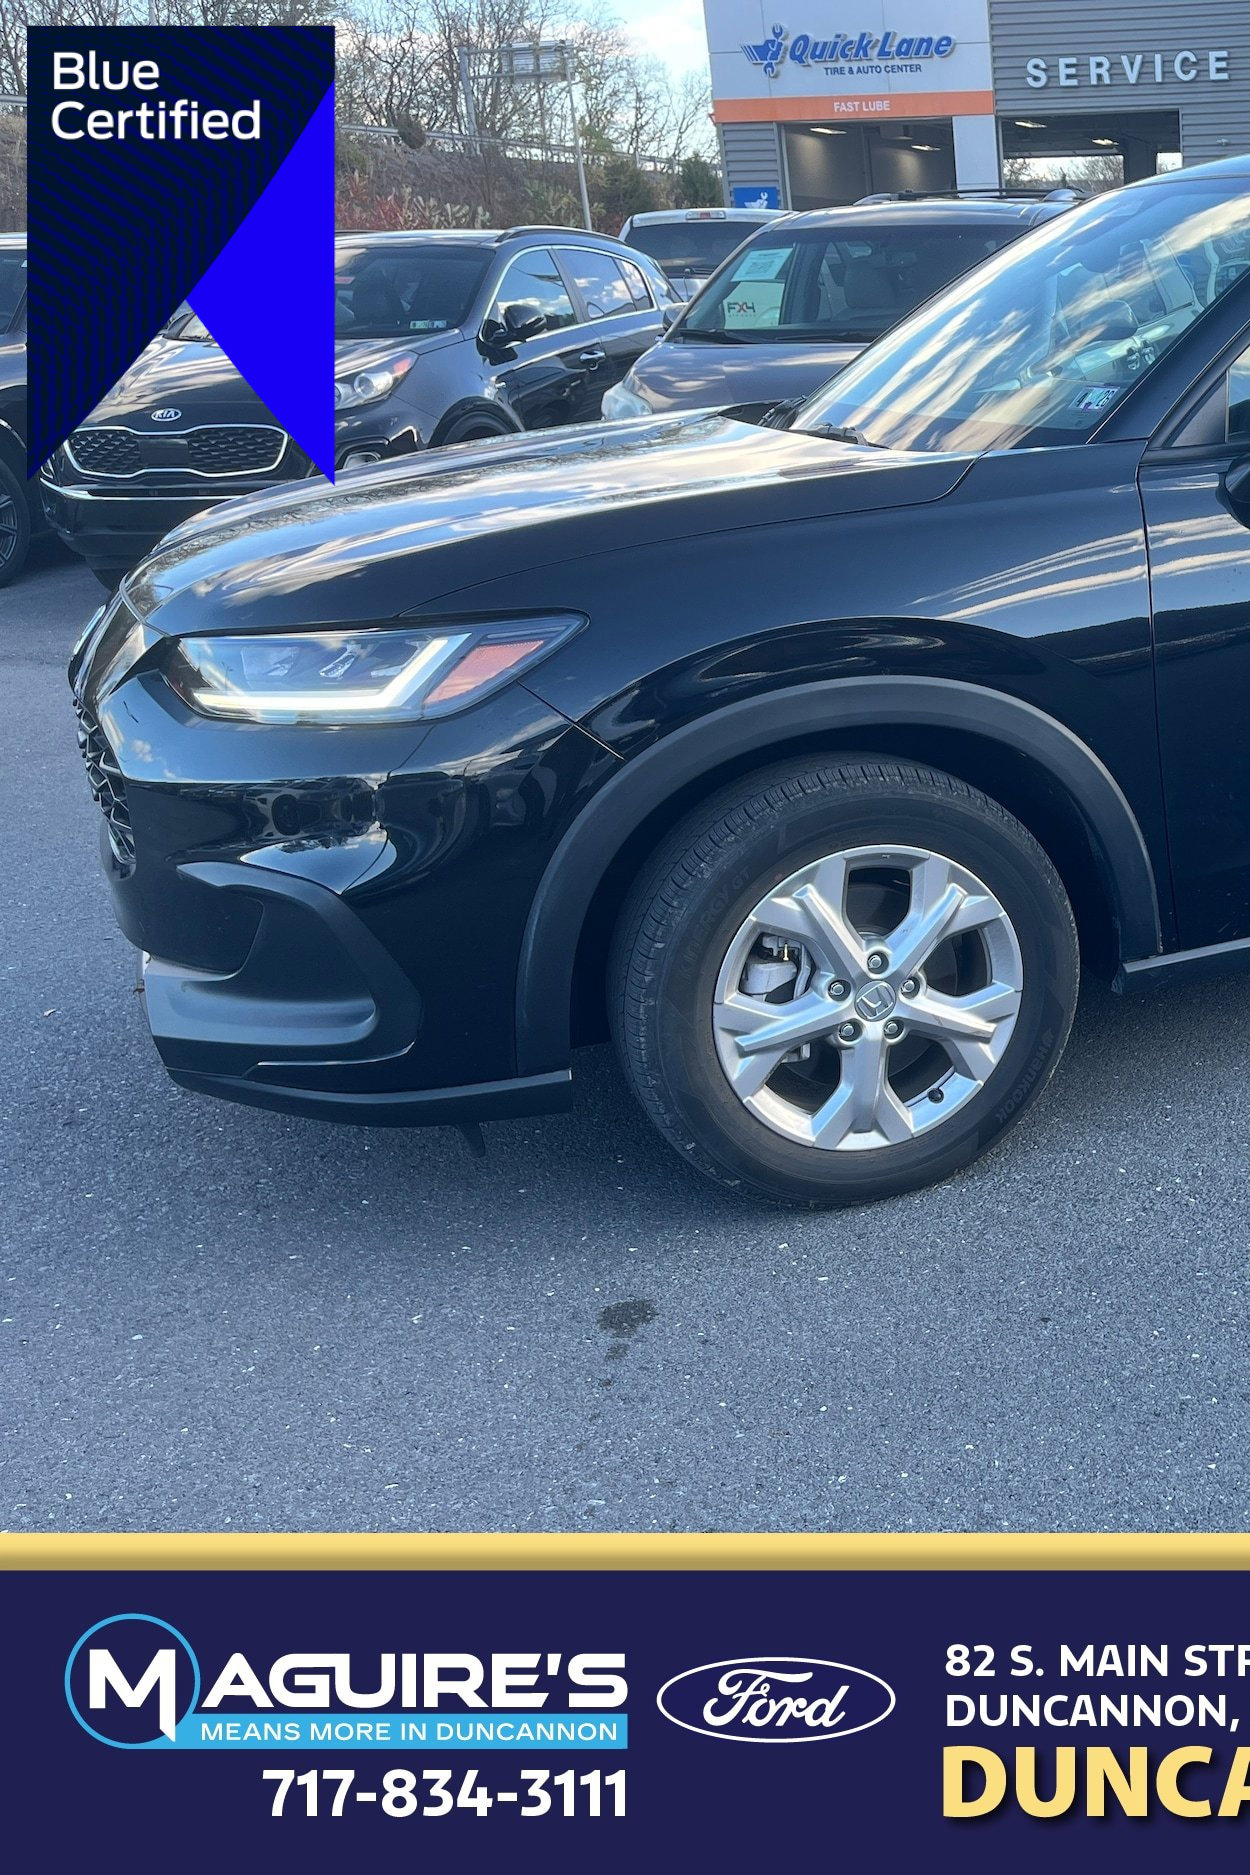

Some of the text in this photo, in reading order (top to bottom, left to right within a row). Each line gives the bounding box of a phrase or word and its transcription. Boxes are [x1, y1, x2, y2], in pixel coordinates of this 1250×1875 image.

[788, 31, 955, 68] Quick Lane
[824, 63, 922, 76] TIRE & AUTO CENTER
[1026, 50, 1230, 89] SERVICE
[833, 100, 891, 113] FAST LUBE
[727, 302, 756, 313] FX4
[154, 410, 175, 418] KIA
